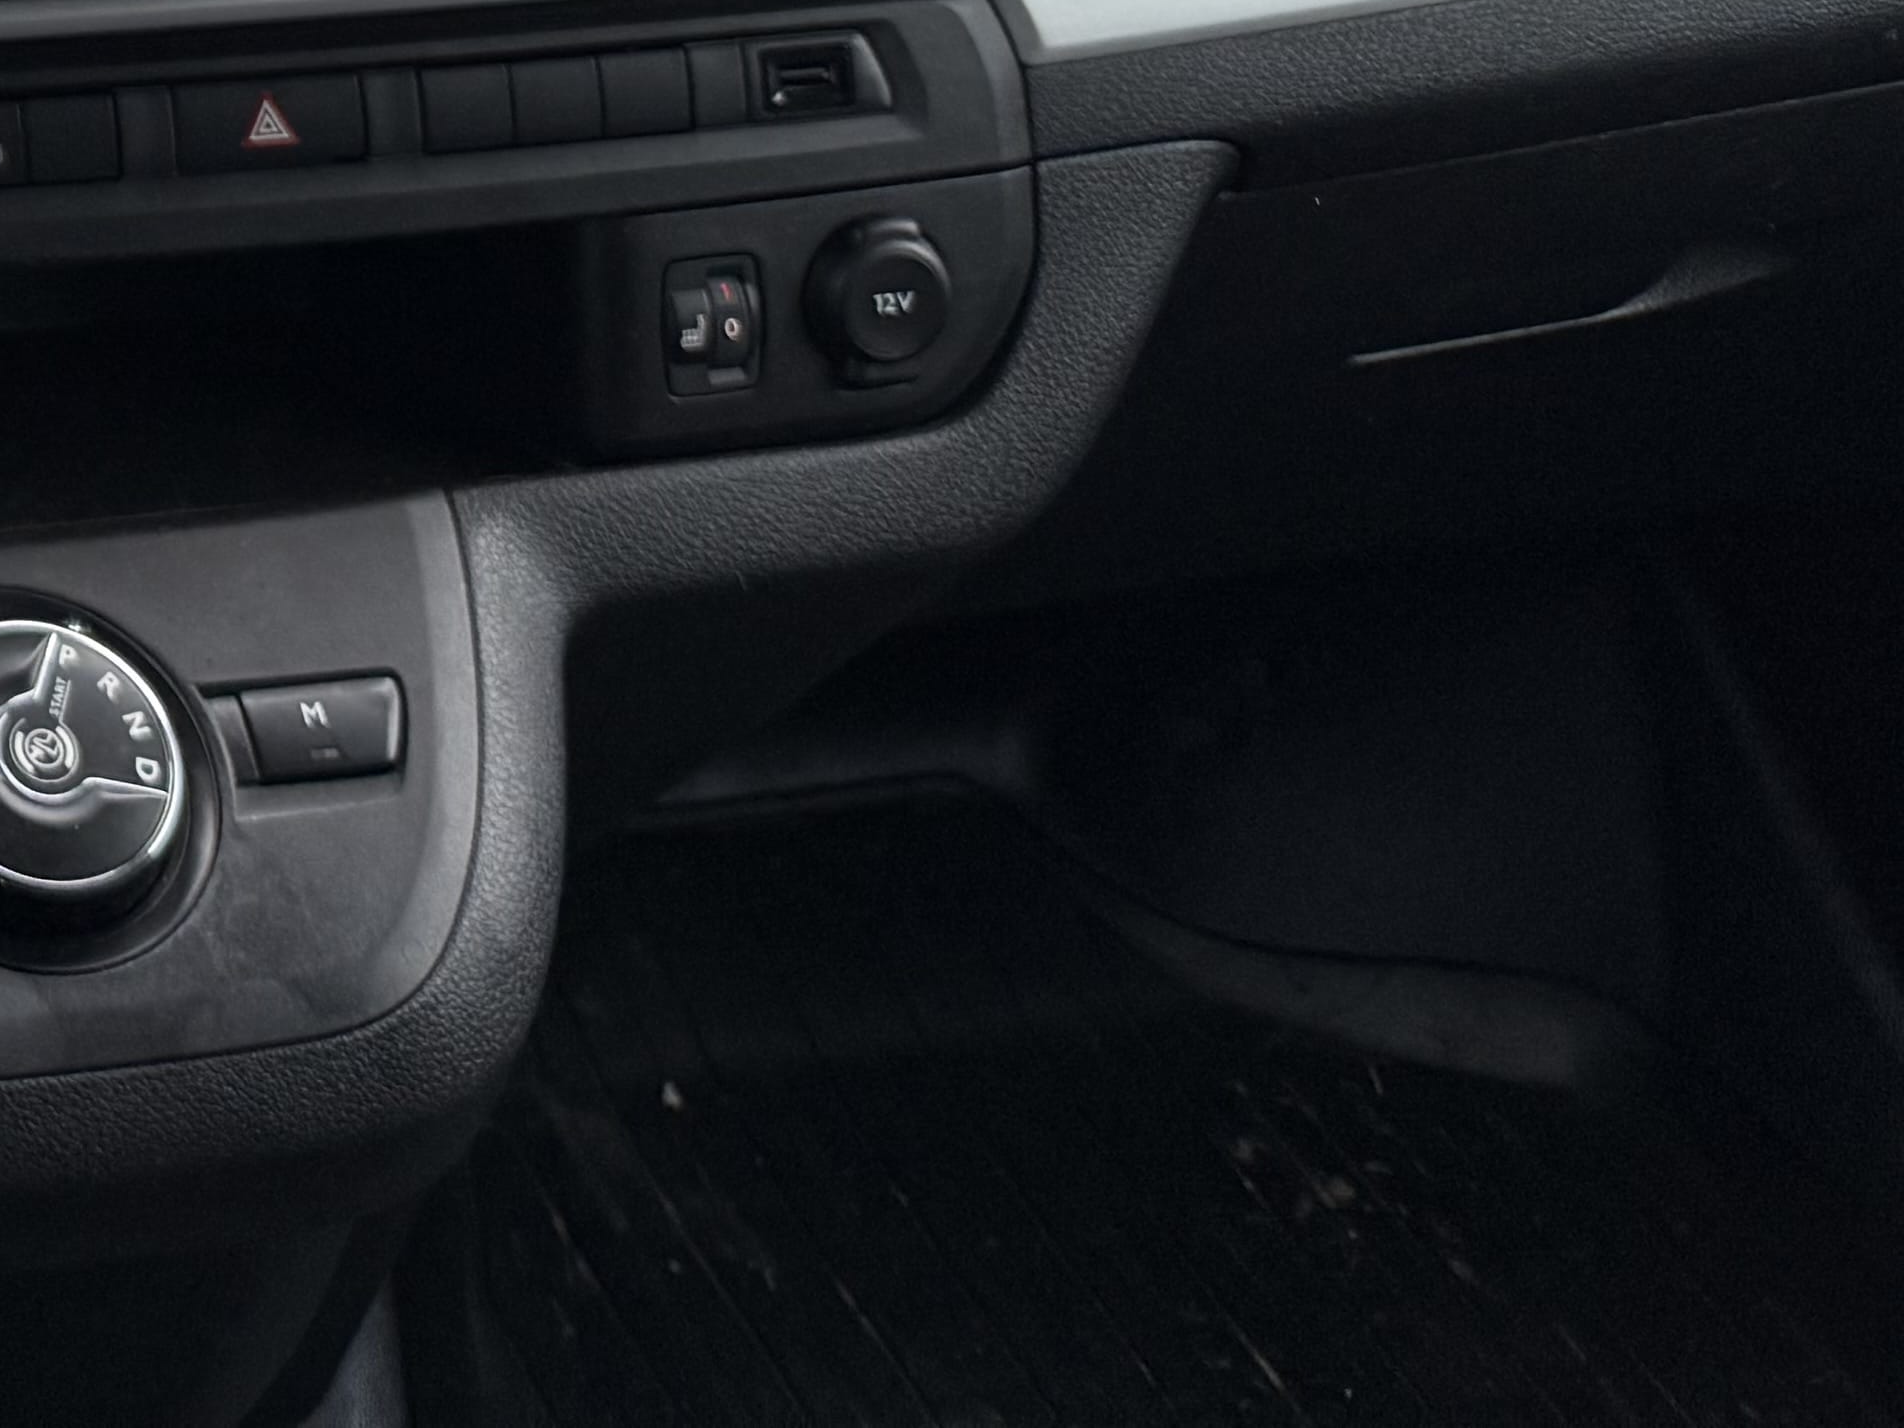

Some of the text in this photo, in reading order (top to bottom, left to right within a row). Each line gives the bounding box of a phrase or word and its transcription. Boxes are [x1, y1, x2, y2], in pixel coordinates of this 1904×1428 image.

[873, 290, 916, 317] 12V
[58, 644, 78, 668] P
[47, 676, 67, 717] START
[96, 671, 120, 699] R
[122, 711, 152, 739] N
[299, 700, 330, 730] M
[135, 755, 162, 783] D
